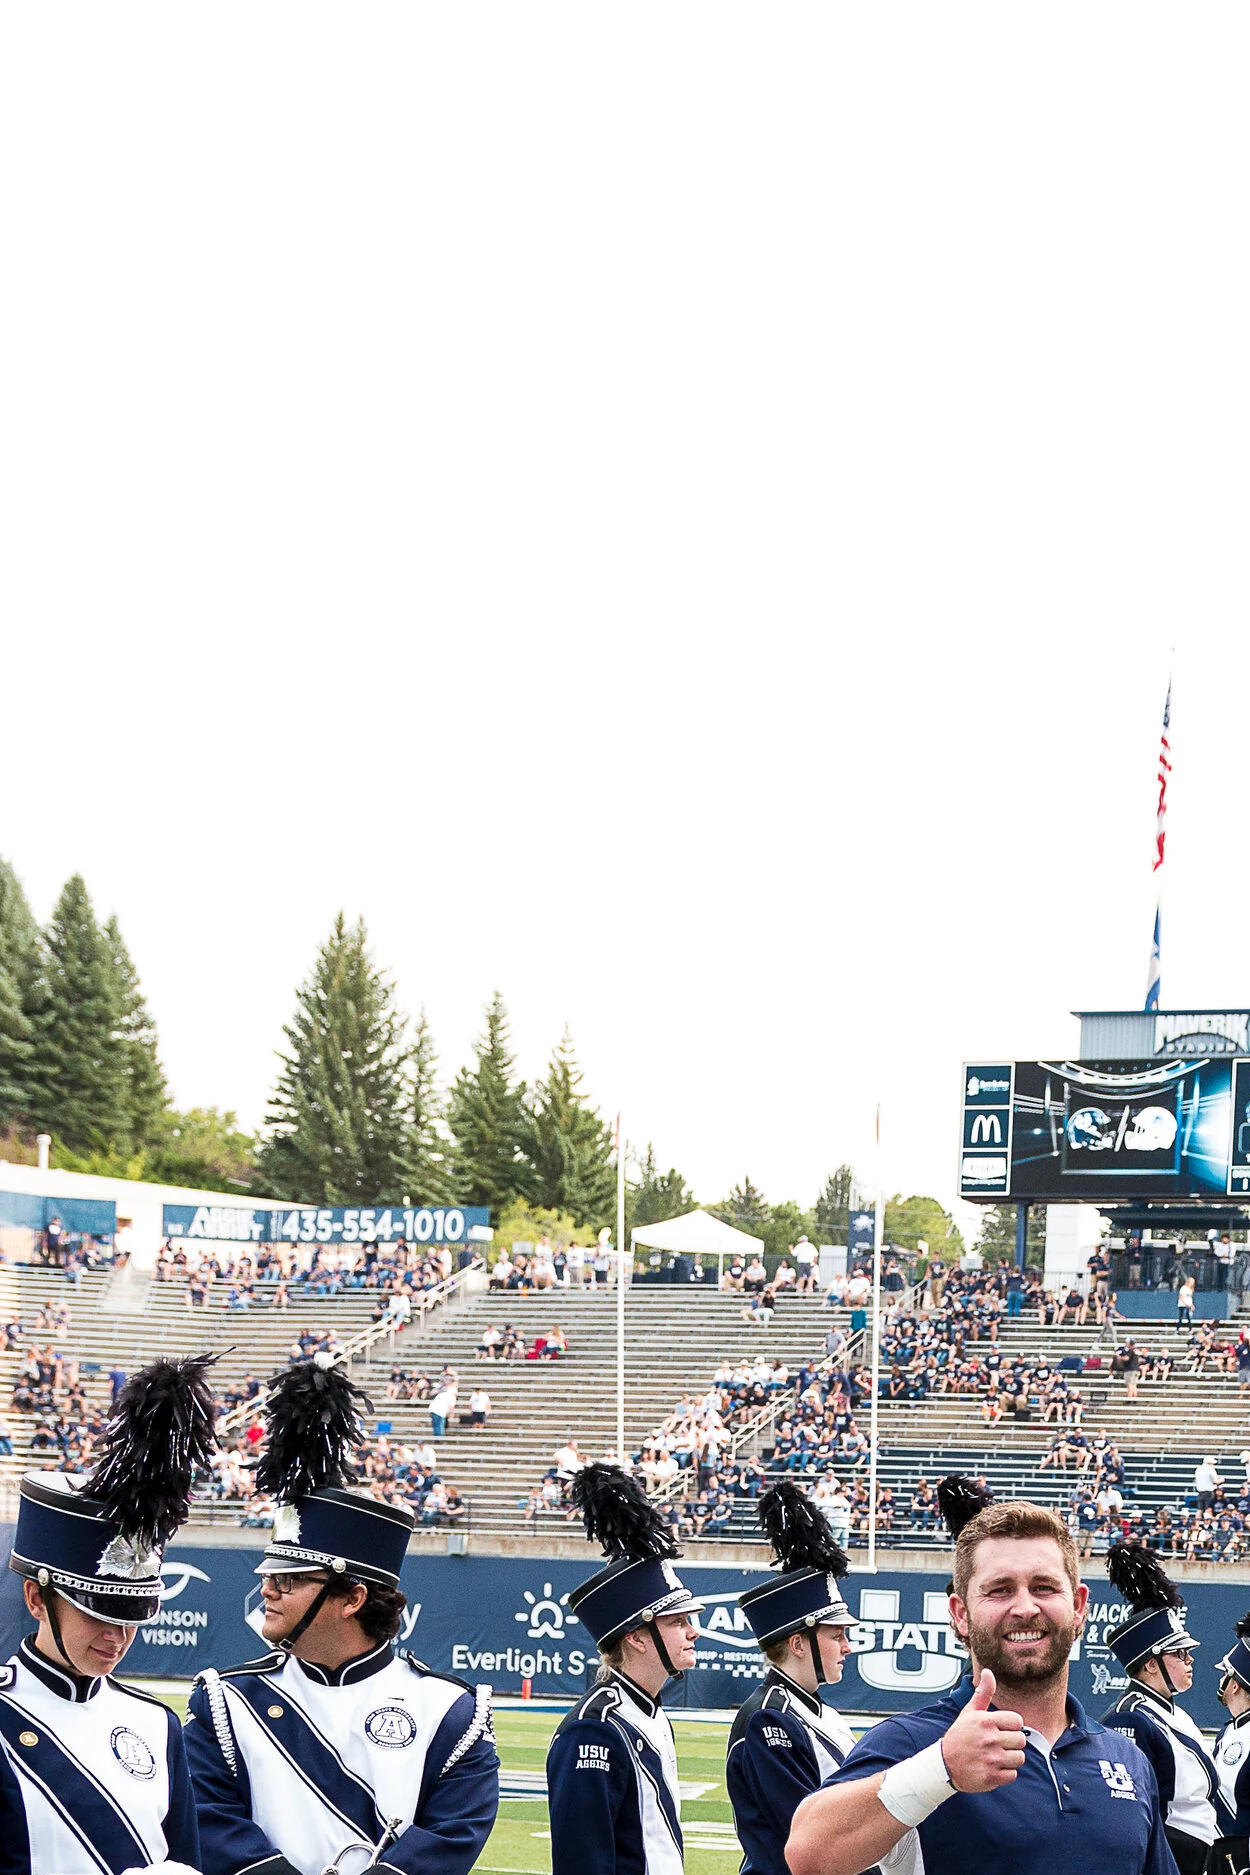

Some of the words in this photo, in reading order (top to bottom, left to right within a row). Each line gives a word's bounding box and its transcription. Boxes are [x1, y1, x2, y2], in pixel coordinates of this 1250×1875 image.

[1154, 1014, 1249, 1054] MAVERIK
[282, 1209, 465, 1242] 435-554-1010
[141, 1628, 198, 1647] VISION
[848, 1620, 970, 1660] STATE
[452, 1644, 563, 1679] Everlight
[575, 1759, 611, 1772] AGGIES
[578, 1744, 610, 1760] USU
